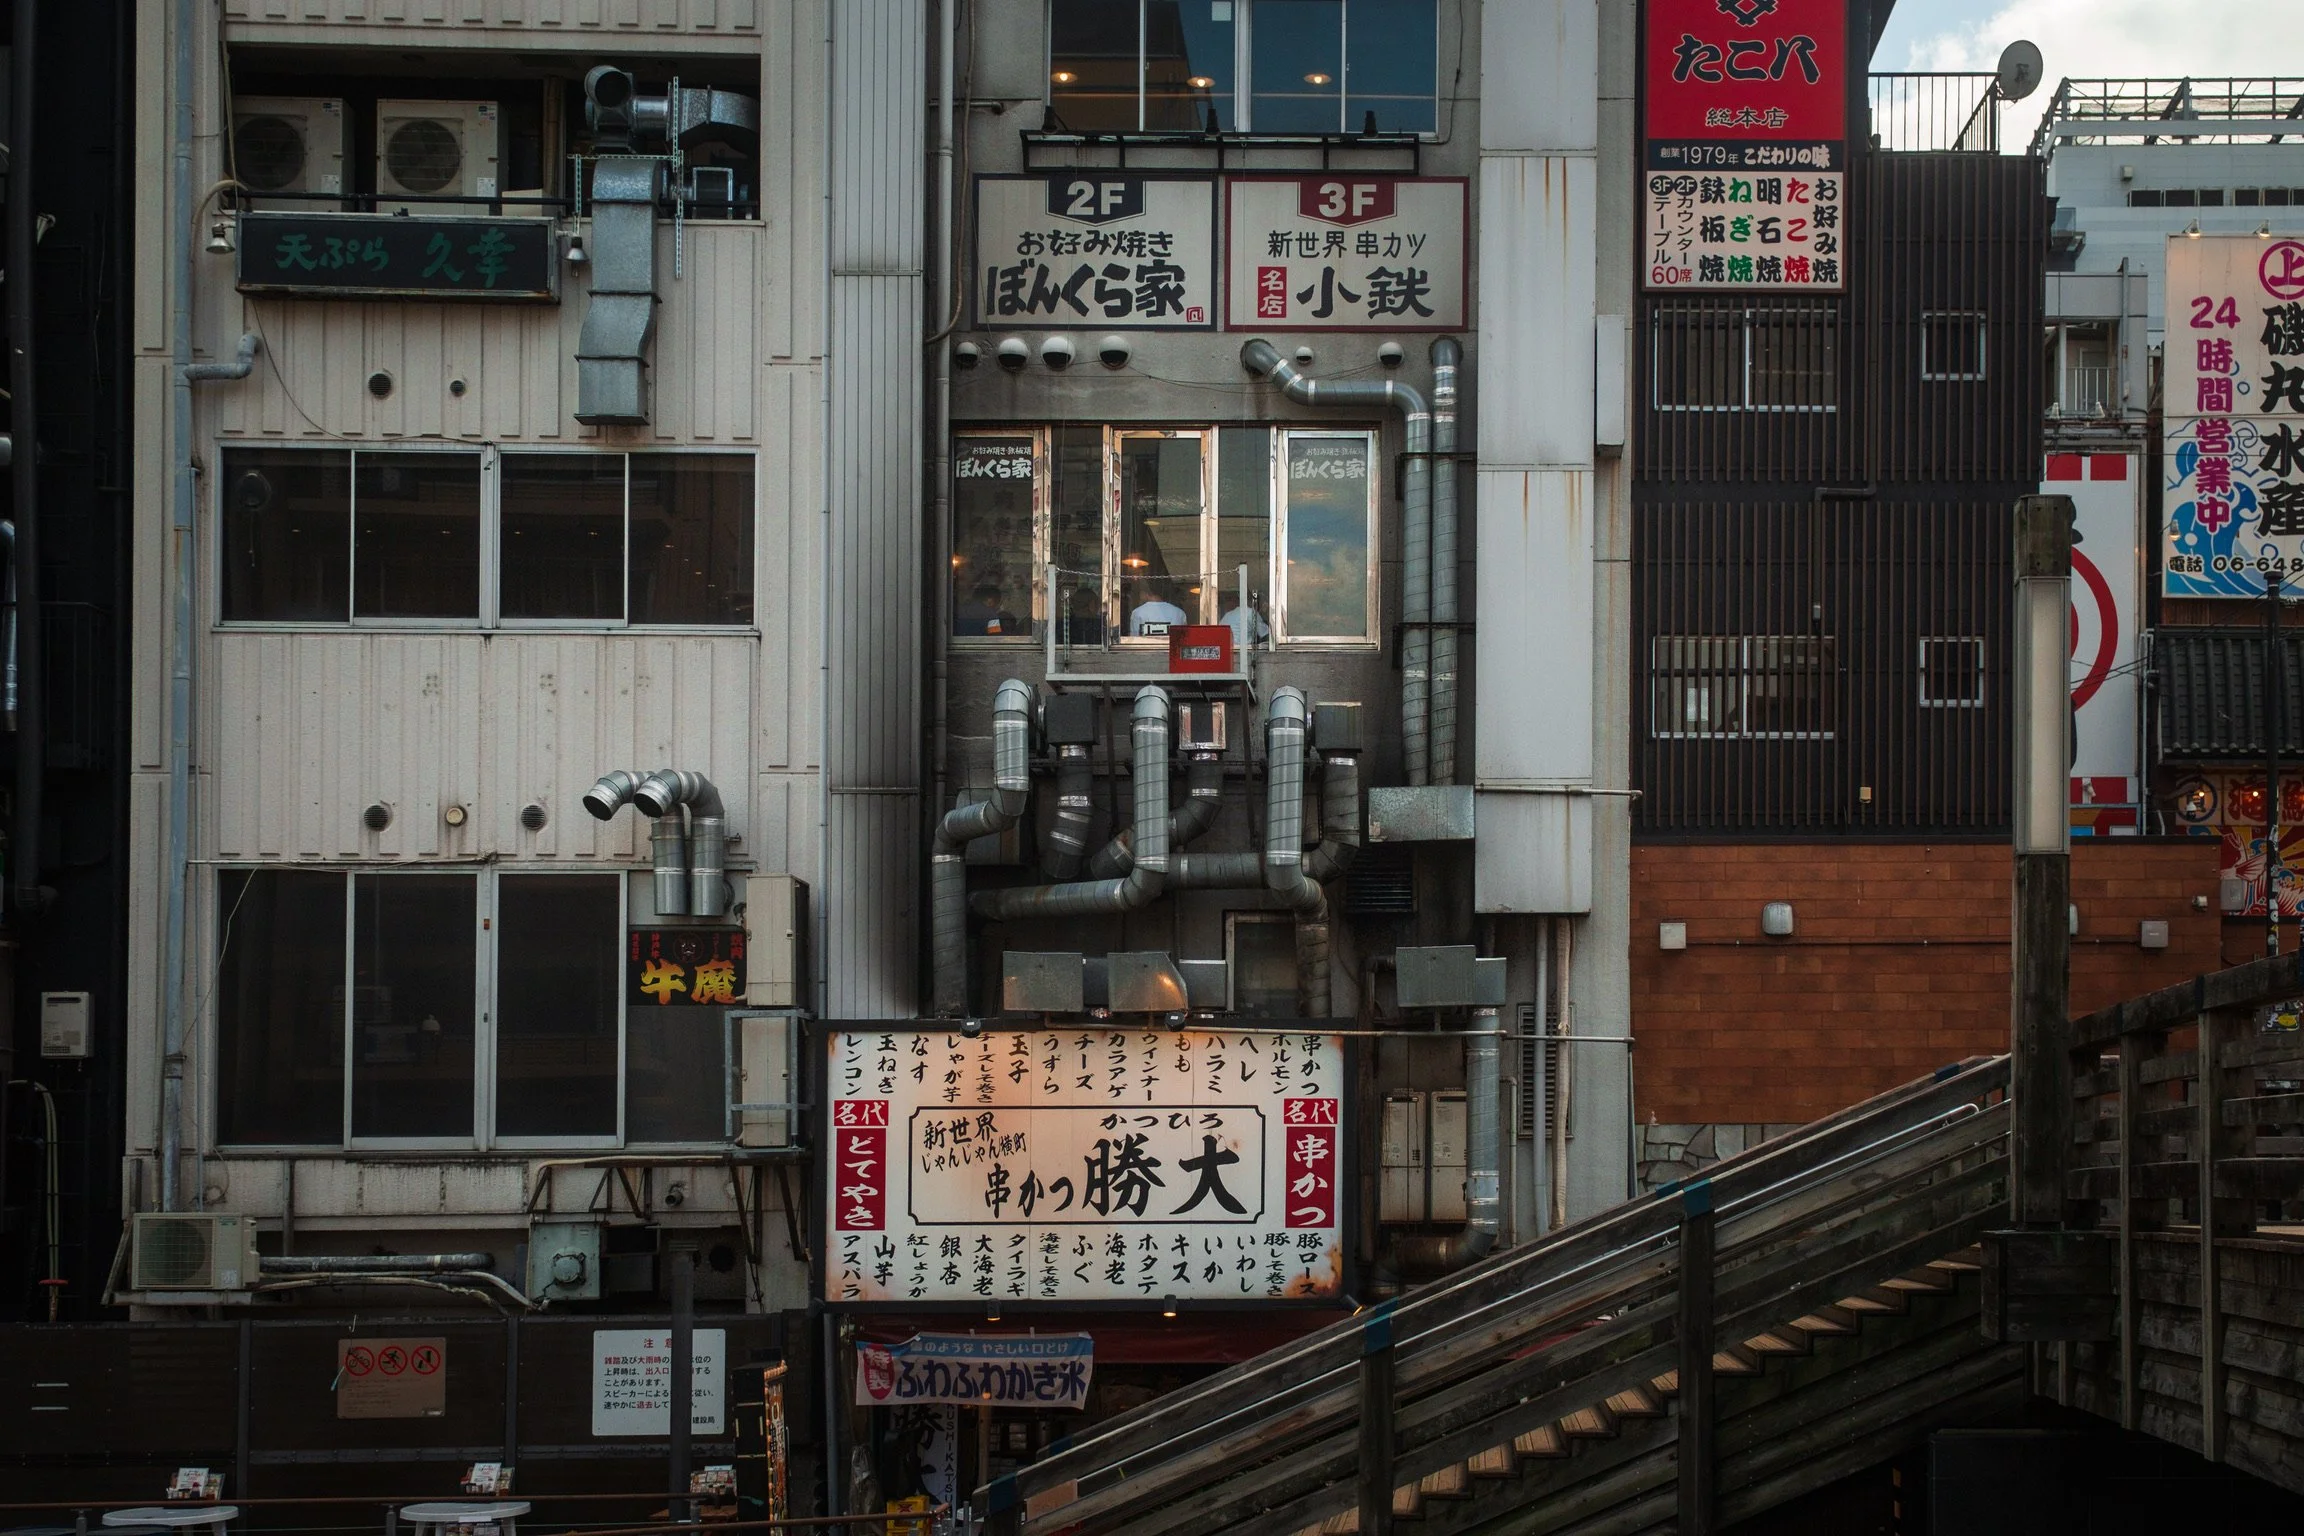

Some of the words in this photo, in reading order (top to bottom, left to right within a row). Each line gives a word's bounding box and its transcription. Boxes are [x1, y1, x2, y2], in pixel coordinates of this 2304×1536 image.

[1705, 106, 1789, 129] 総本店
[1651, 178, 1672, 192] 3F
[1660, 146, 1739, 166] 創業1979年
[1744, 145, 1830, 169] こだわりの味
[1675, 178, 1696, 192] 2F
[1066, 181, 1126, 216] 2F
[1317, 182, 1378, 217] 3F
[276, 233, 390, 271] 天ぷら
[421, 226, 516, 288] 久幸
[1016, 229, 1174, 259] お好み焼き
[1267, 230, 1348, 259] 新世界
[1354, 230, 1427, 259] 串カツ
[1653, 197, 1672, 265] テーブル
[1677, 196, 1694, 265] カウンター
[1699, 176, 1726, 283] 鉄板焼
[1727, 177, 1754, 283] ねぎ焼
[1756, 177, 1782, 283] 明石焼
[1784, 177, 1810, 283] たこ焼
[1812, 178, 1839, 284] お好み焼
[984, 260, 1186, 319] ぼんくら家
[1260, 269, 1286, 316] 名店
[1296, 265, 1436, 320] 小鉄
[1652, 266, 1693, 285] 60席
[2190, 295, 2242, 534] 24時間営業中
[956, 457, 1032, 478] ぼんくら家
[1290, 458, 1366, 479] ぼんくら家
[2168, 555, 2203, 573] 電話
[845, 1033, 863, 1096] レンコン
[877, 1033, 898, 1095] 玉ねぎ
[910, 1034, 930, 1084] なす
[942, 1033, 965, 1104] じゃが芋
[975, 1032, 996, 1104] チーズしそ巻き
[1008, 1033, 1029, 1084] 玉子
[1042, 1033, 1061, 1095] うずら
[1074, 1033, 1095, 1090] チーズ
[1107, 1033, 1128, 1099] カラアゲ
[1141, 1033, 1160, 1102] ウインナー
[1174, 1033, 1191, 1073] もも
[1206, 1035, 1226, 1094] ハラミ
[1271, 1033, 1292, 1095] ホルモン
[1300, 1033, 1321, 1096] 串かつ
[835, 1101, 886, 1125] 名代
[923, 1111, 999, 1151] 新世界
[1100, 1112, 1225, 1130] かつひろ
[1284, 1099, 1335, 1124] 名代
[842, 1135, 878, 1227] どてやき
[920, 1132, 1027, 1174] じゃんじゃん横町
[984, 1163, 1075, 1219] 串かつ
[1082, 1132, 1248, 1217] 勝大
[1291, 1133, 1328, 1226] 串かつ
[842, 1234, 861, 1299] アスパラ
[873, 1234, 896, 1287] 山芋
[906, 1233, 930, 1297] 紅しょうが
[938, 1234, 962, 1286] 銀杏
[972, 1234, 995, 1296] 大海老
[1007, 1233, 1027, 1297] タイラギ
[1039, 1232, 1061, 1297] 海老しそ巻き
[1072, 1234, 1094, 1284] ふぐ
[1104, 1232, 1128, 1286] 海老
[1137, 1233, 1159, 1294] ホタテ
[1171, 1233, 1191, 1284] キス
[1203, 1235, 1223, 1283] いか
[1236, 1234, 1256, 1293] いわし
[1263, 1232, 1290, 1297] 豚しそ巻き
[1296, 1232, 1323, 1296] 豚ロース
[604, 1367, 711, 1376] 上昇時は、出入口する
[982, 1342, 1069, 1354] やさしい口どけ
[604, 1389, 715, 1398] スピーカーによる従い、
[895, 1359, 1087, 1402] ふわふわかき氷
